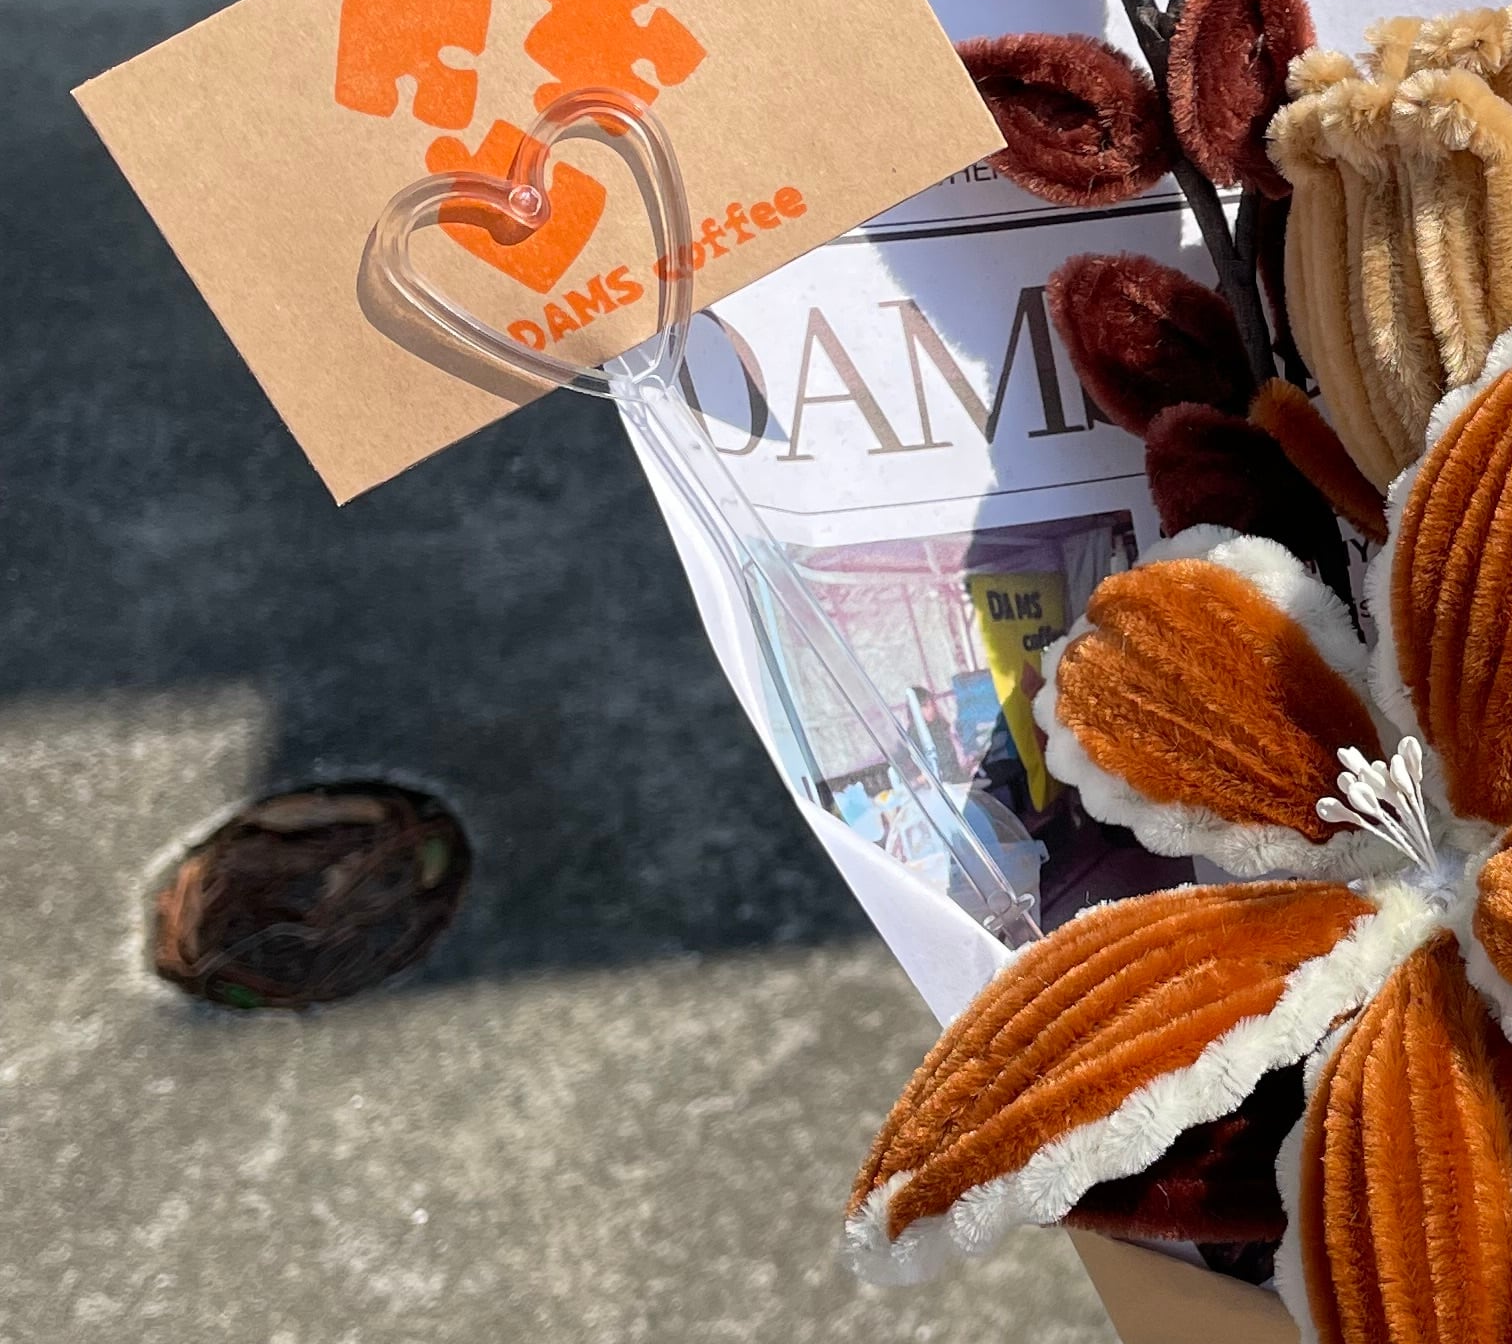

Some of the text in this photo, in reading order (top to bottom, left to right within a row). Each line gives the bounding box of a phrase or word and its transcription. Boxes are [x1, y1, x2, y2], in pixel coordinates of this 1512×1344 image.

[507, 186, 808, 351] DAMS coffee
[668, 285, 1114, 461] DAM
[986, 590, 1042, 620] DAMS
